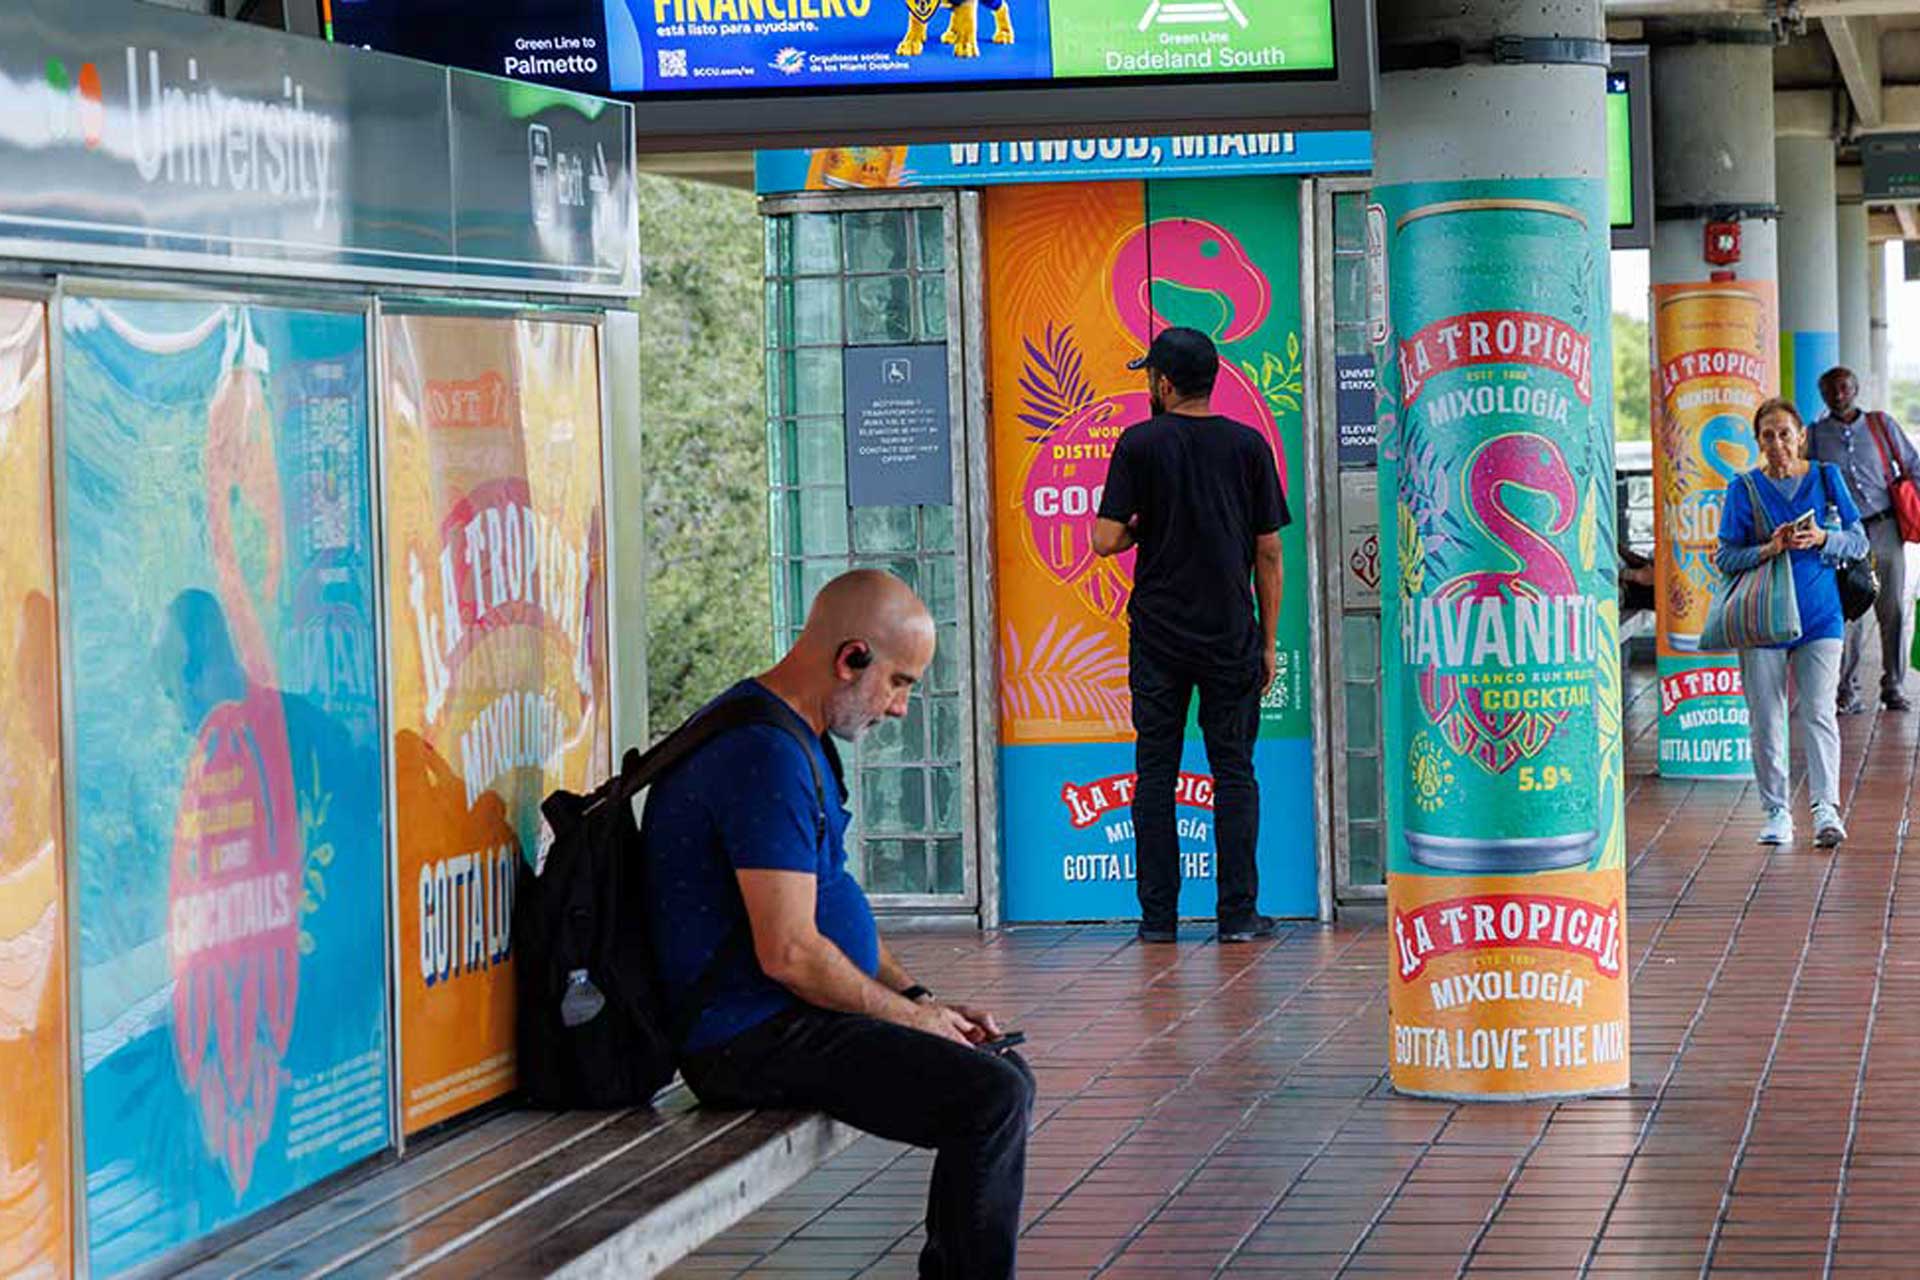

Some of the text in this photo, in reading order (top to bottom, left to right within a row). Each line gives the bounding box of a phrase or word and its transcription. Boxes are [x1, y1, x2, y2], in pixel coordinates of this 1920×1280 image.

[515, 37, 596, 50] Green Line to
[656, 19, 819, 37] está listo para ayudarte.
[1159, 31, 1230, 45] Green Line
[504, 55, 598, 75] Palmetto
[840, 62, 867, 72] Miami
[868, 61, 910, 72] Dolphins
[1105, 47, 1286, 71] Dadeland South
[127, 46, 334, 230] University
[1400, 340, 1431, 400] LA
[1427, 385, 1571, 426] MIXOLOGÍA
[1053, 443, 1115, 460] DISTIL
[1693, 739, 1734, 763] LOVE
[1065, 785, 1109, 824] LA
[1063, 854, 1122, 882] GOTTA
[173, 871, 291, 957] COCKTAILS
[418, 851, 486, 981] GOTTA
[1395, 901, 1620, 977] LA TROPICAL
[1429, 969, 1586, 1012] MIXOLOGÍA
[1456, 1026, 1529, 1071] LOVE
[1533, 1025, 1588, 1068] THE
